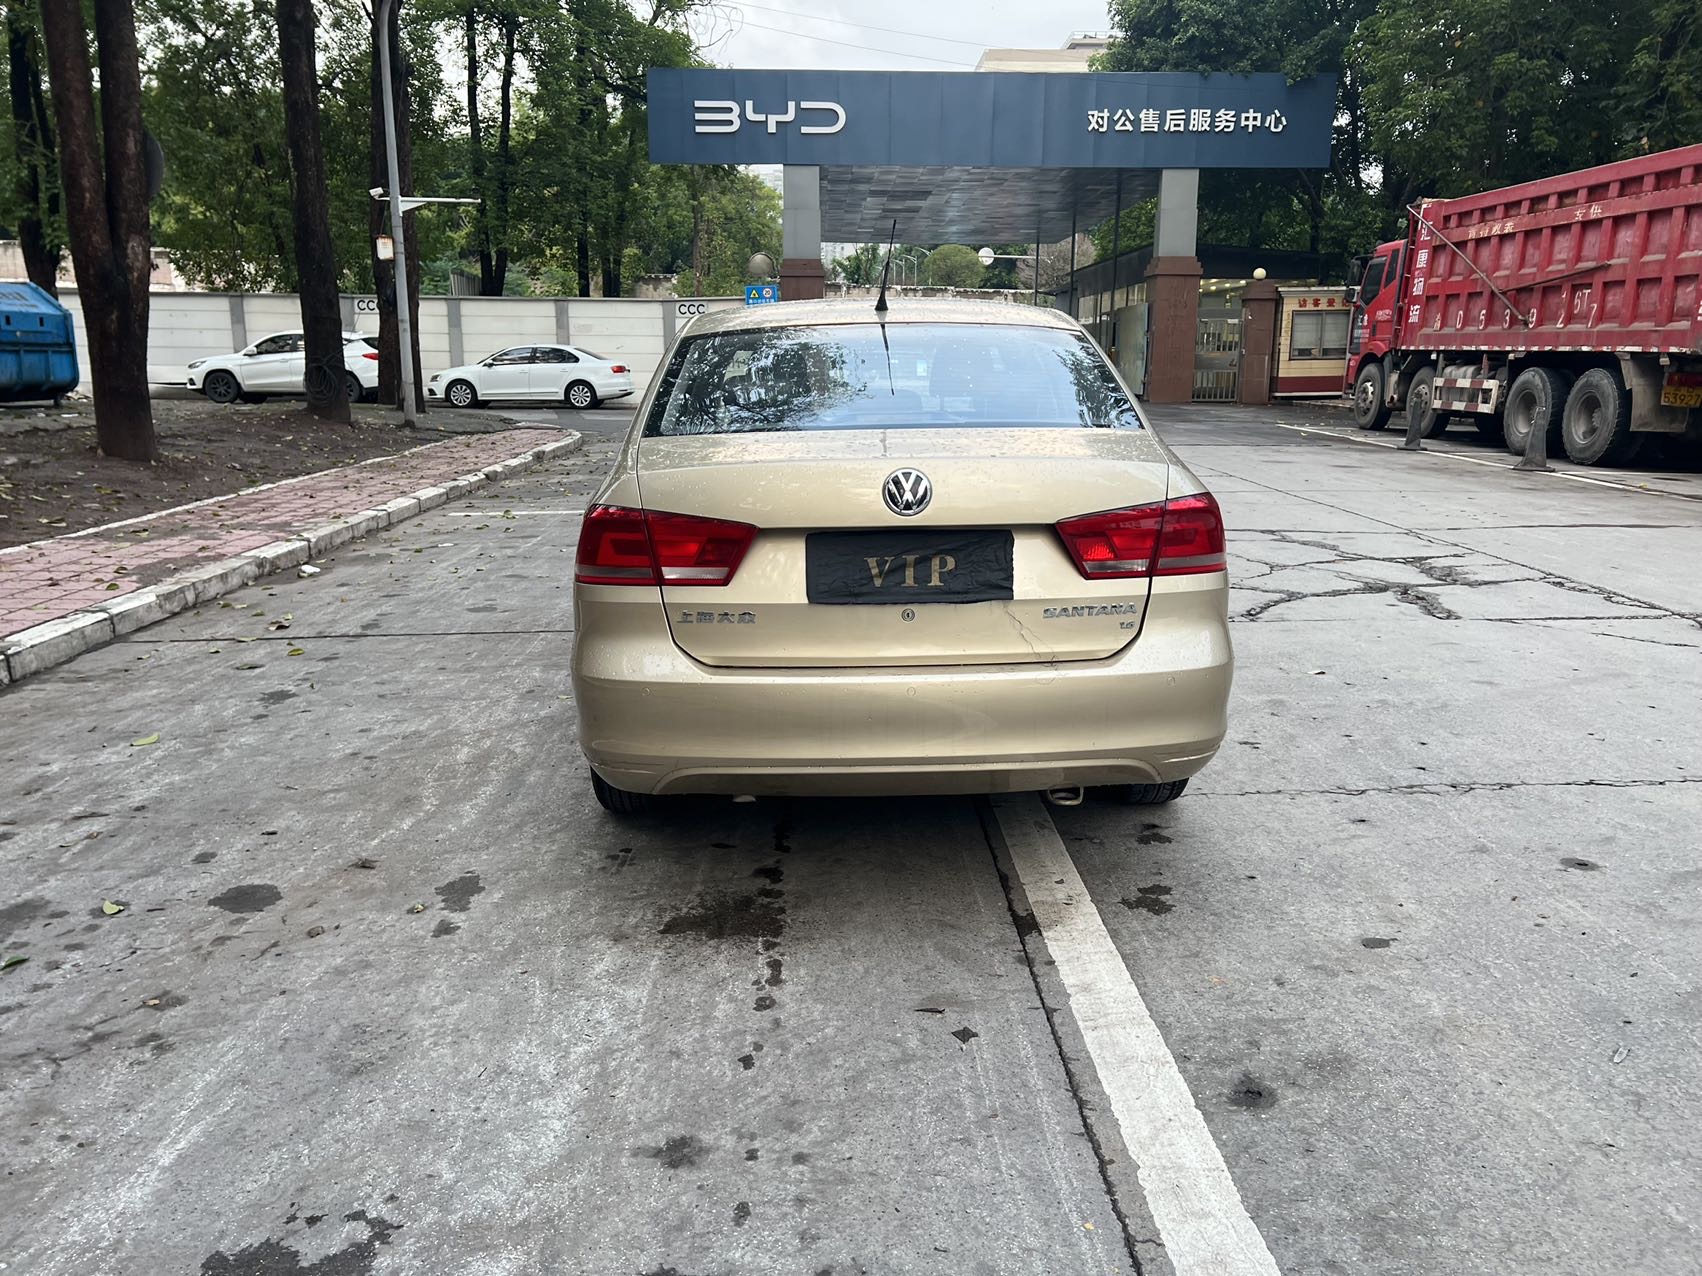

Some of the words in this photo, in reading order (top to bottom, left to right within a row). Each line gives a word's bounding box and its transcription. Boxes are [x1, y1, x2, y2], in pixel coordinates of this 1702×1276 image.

[694, 100, 846, 134] BYD
[1086, 108, 1288, 134] 对公售后服务中心
[357, 300, 379, 311] CC
[678, 303, 706, 315] CCC
[864, 554, 956, 588] VIP
[677, 610, 756, 624] 上海大众
[1043, 602, 1137, 619] SANTANA
